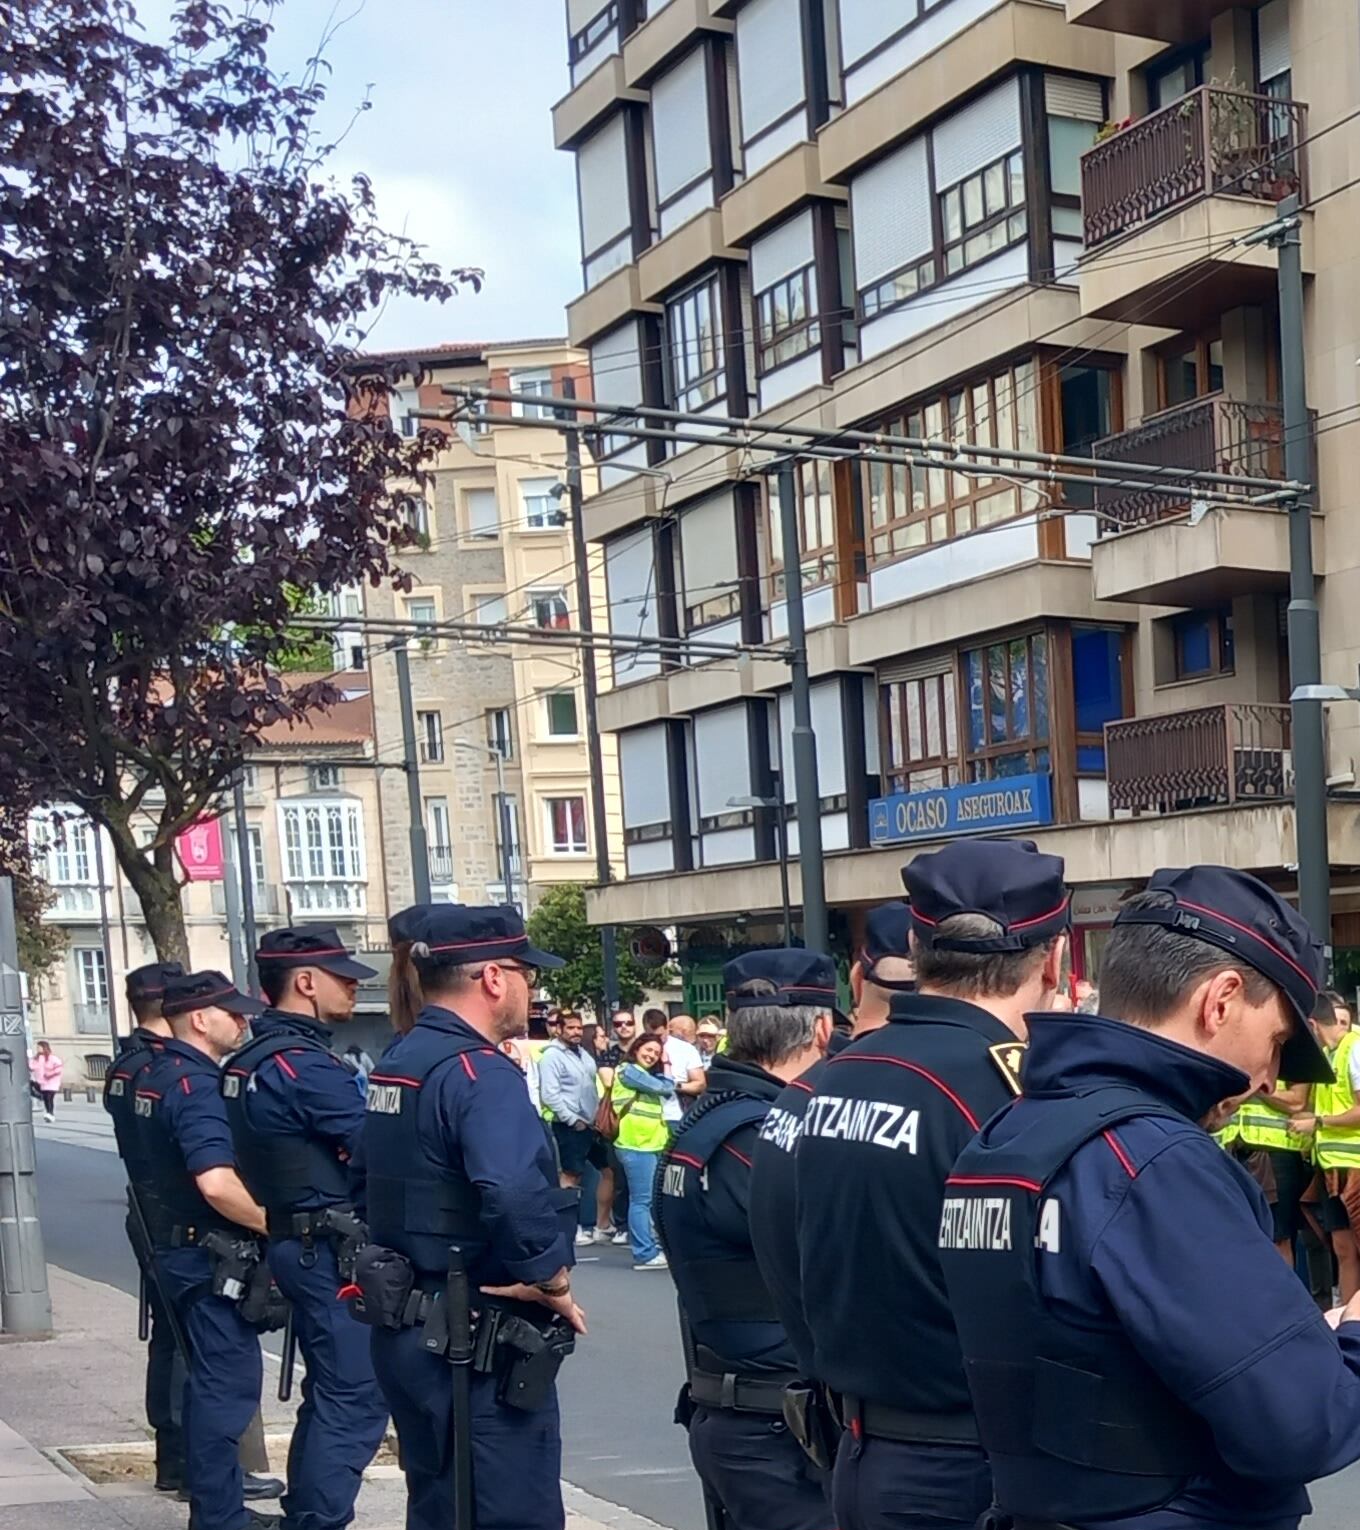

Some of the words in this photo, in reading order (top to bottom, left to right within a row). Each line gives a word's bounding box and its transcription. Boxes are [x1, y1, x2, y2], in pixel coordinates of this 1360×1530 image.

[896, 797, 947, 833] OCASO
[957, 789, 1033, 822] ASEGUROAK
[802, 1096, 920, 1155] RTZAINTZA
[938, 1198, 1012, 1250] ERTZAINTZA
